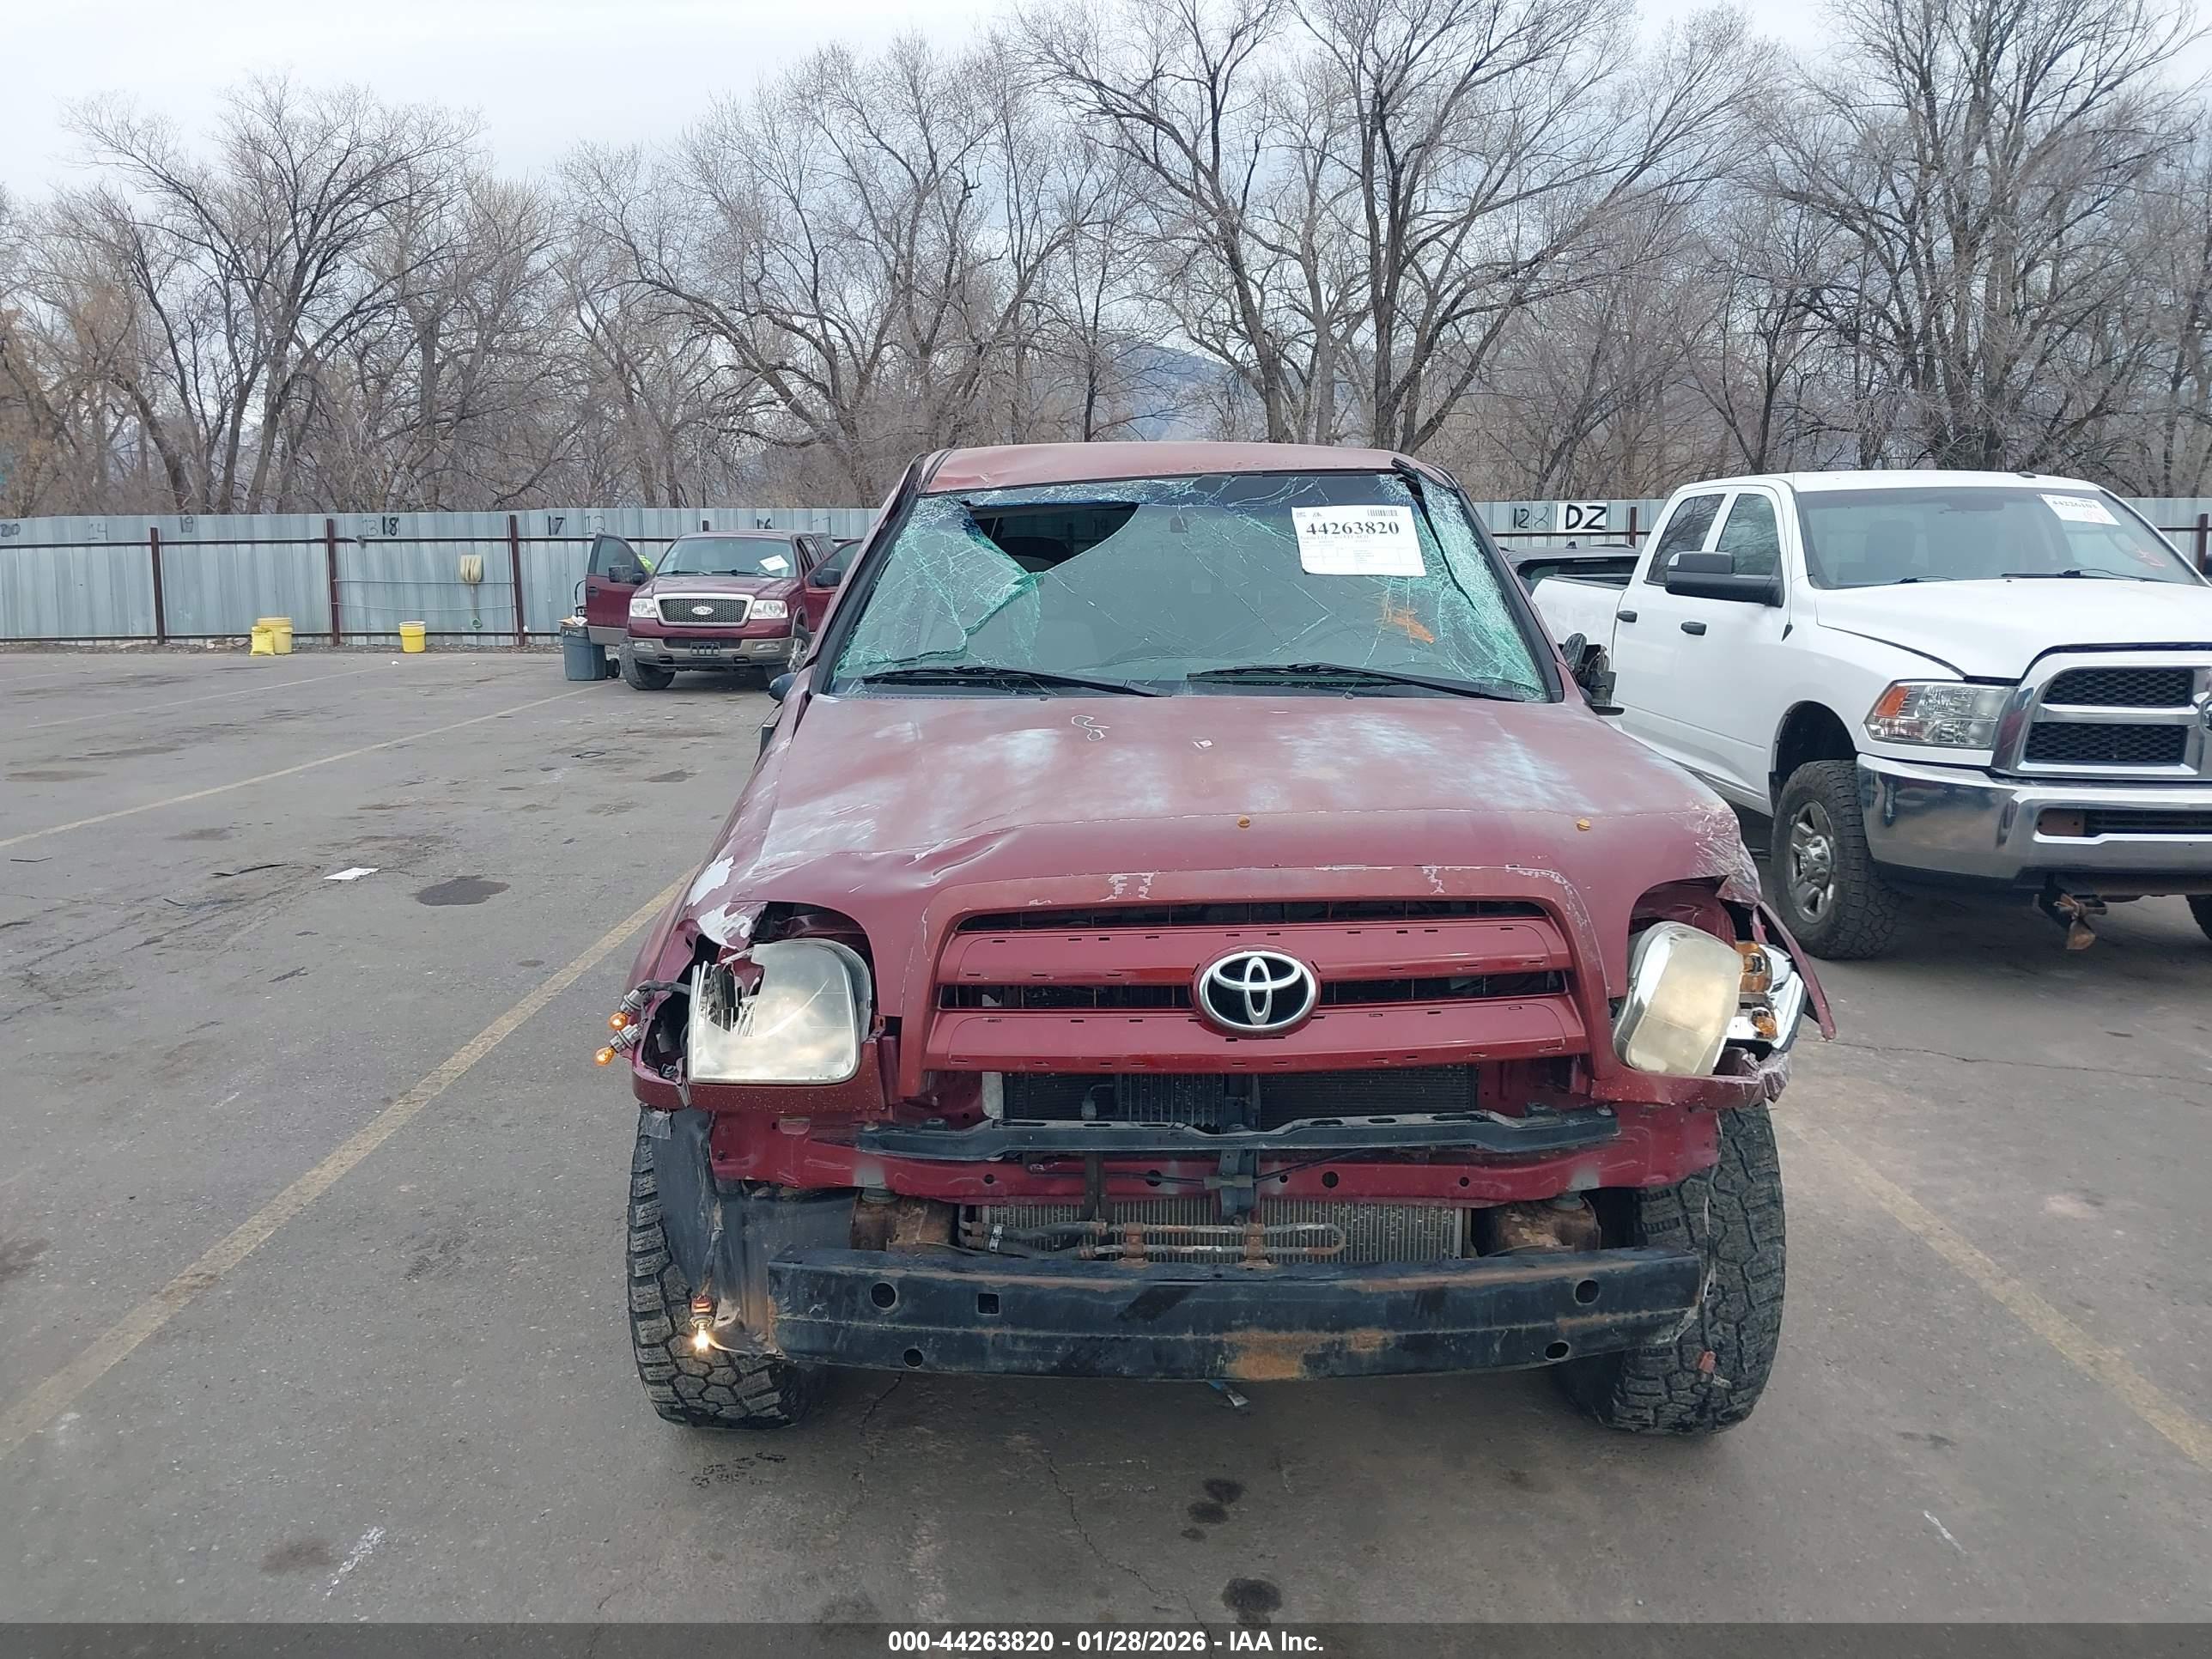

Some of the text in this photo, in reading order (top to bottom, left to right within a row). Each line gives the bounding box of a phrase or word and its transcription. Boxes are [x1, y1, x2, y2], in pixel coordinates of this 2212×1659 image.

[382, 515, 399, 537] 18
[548, 515, 565, 537] 17
[1513, 507, 1530, 530] 12
[1565, 503, 1608, 531] DZ
[1306, 521, 1400, 536] 44263820
